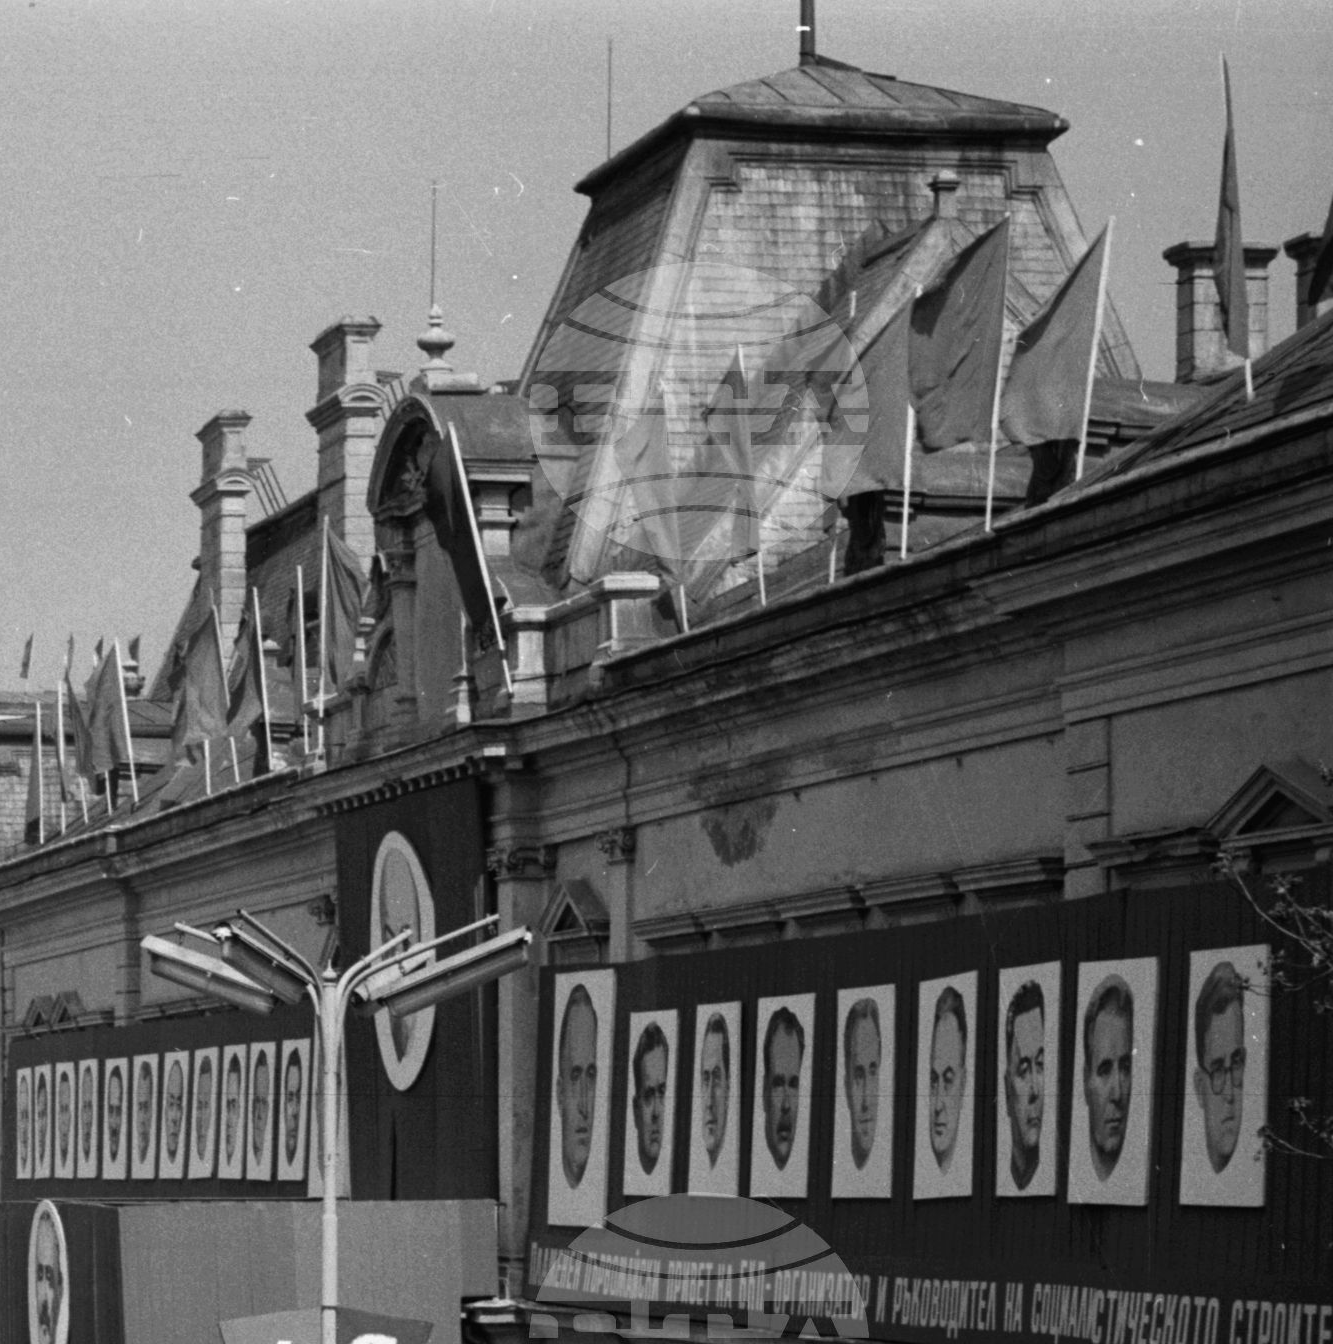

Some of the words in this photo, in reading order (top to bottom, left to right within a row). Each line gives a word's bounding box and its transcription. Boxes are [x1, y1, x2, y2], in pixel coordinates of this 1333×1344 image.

[666, 1260, 713, 1306] ПРИВЕТ
[716, 1263, 733, 1308] НА
[875, 1276, 888, 1323] И
[891, 1277, 997, 1339] РЪКОВОДИТЕЛ
[1004, 1283, 1023, 1333] НА
